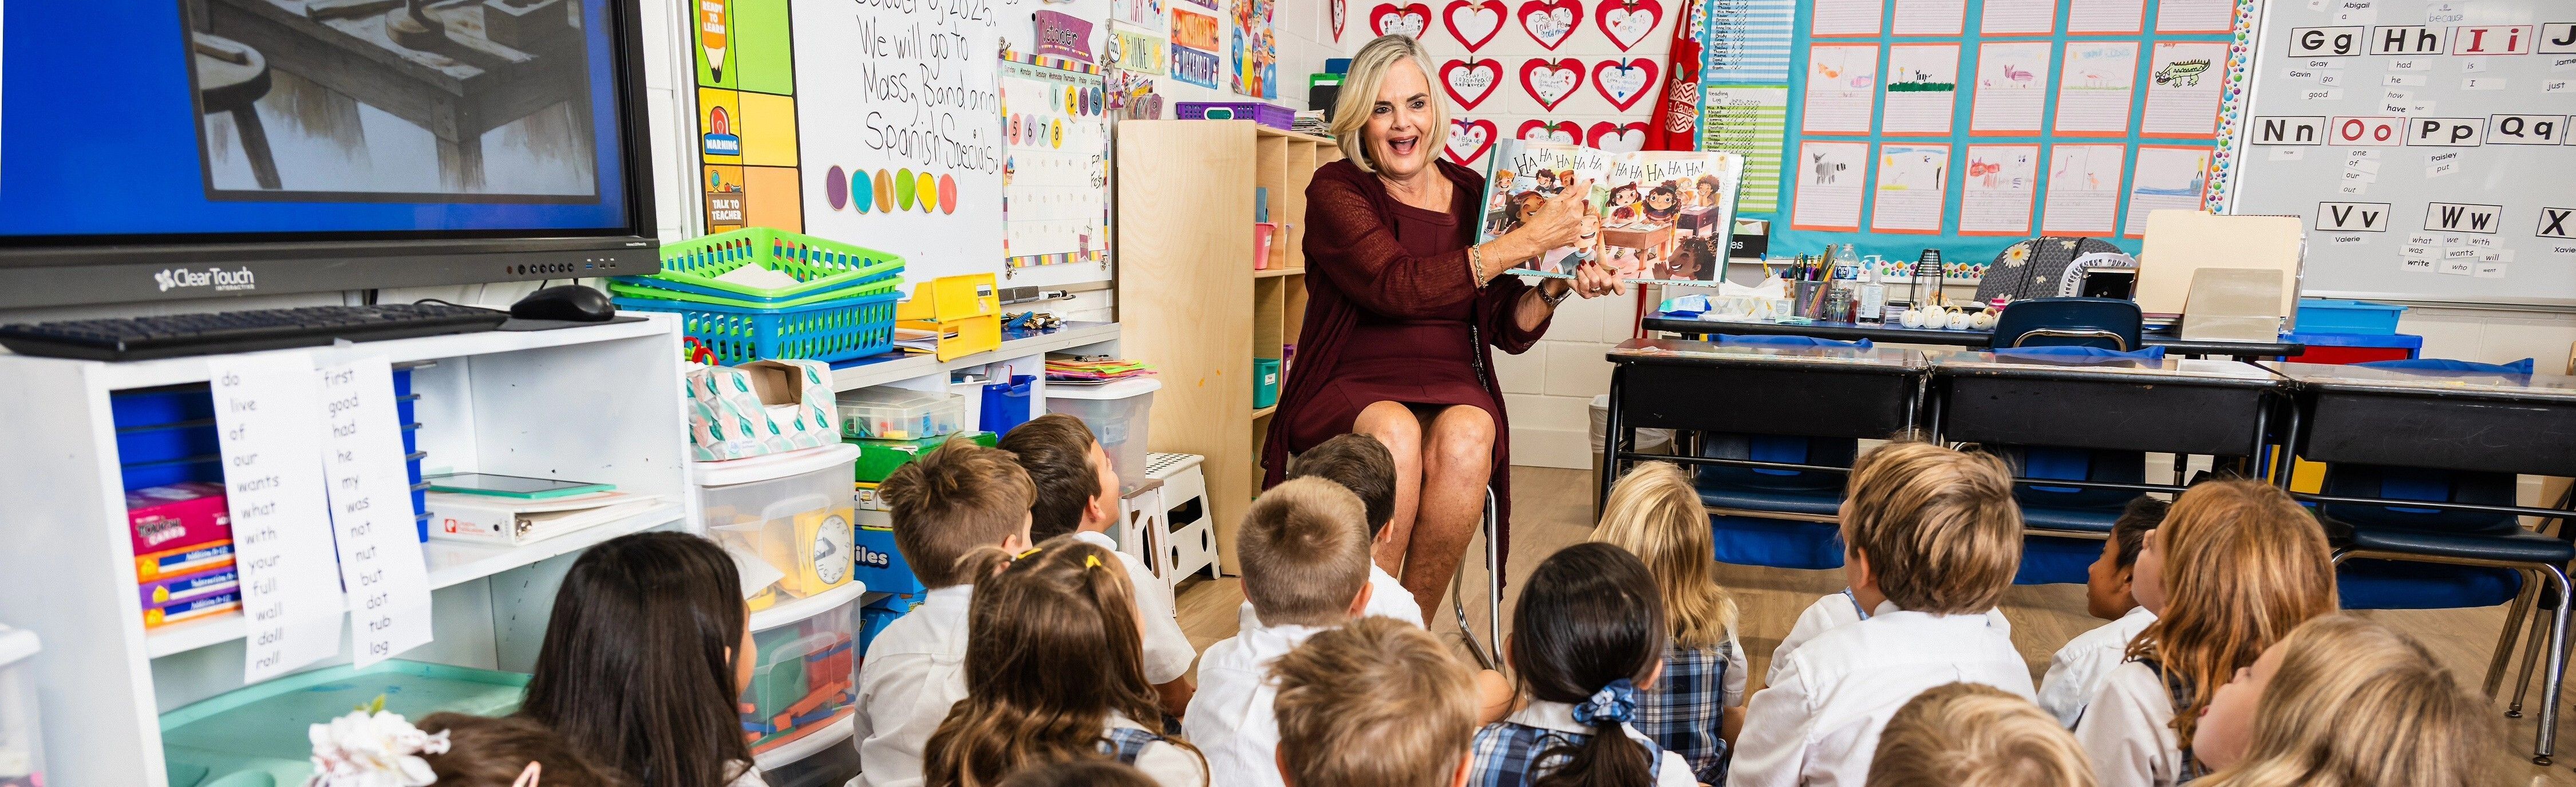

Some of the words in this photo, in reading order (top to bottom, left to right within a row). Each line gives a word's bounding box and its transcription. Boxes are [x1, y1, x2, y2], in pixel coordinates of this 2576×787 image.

[702, 1, 722, 14] READY
[1534, 13, 1560, 23] Jesus
[1564, 8, 1571, 18] is
[709, 13, 718, 23] TO
[2429, 13, 2463, 22] because
[704, 22, 725, 35] LEARN
[1042, 18, 1078, 48] October
[1182, 13, 1210, 47] NOVEMBER
[1535, 22, 1552, 33] love
[856, 15, 887, 58] We
[894, 22, 922, 60] will
[930, 33, 948, 80] go
[951, 21, 968, 61] to
[1111, 41, 1119, 54] COOL
[1131, 37, 1147, 69] JUNE
[1005, 65, 1016, 74] Sunday
[1020, 68, 1032, 77] Monday
[1036, 70, 1046, 80] Tuesday
[1049, 72, 1062, 81] Wednesday
[1063, 74, 1076, 84] Thursday
[1183, 50, 1210, 85] DECEMBER
[863, 61, 918, 127] Mass,
[919, 63, 965, 111] Band
[970, 72, 997, 121] and
[2547, 82, 2565, 91] just
[1069, 93, 1073, 108] 2
[1081, 95, 1086, 109] 3
[1092, 93, 1099, 109] 4
[2309, 91, 2328, 99] good
[2387, 104, 2405, 112] have
[1013, 121, 1017, 136] 5
[1028, 123, 1032, 137] 6
[1041, 123, 1046, 137] 7
[1055, 127, 1059, 140] 8
[1535, 132, 1562, 141] Jesus
[706, 138, 738, 151] WARNING
[865, 111, 941, 166] Spanish
[941, 113, 998, 184] Specials.
[1514, 154, 1537, 175] HA
[1540, 148, 1552, 162] HA
[1556, 155, 1570, 168] HA
[1574, 156, 1586, 170] HA
[1590, 156, 1602, 170] HA
[2431, 152, 2457, 162] Paisley
[1616, 163, 1627, 176] HA
[1630, 166, 1642, 179] HA
[1647, 165, 1665, 181] HA
[1668, 162, 1681, 175] HA
[2436, 164, 2449, 173] put
[713, 199, 729, 210] TALK
[729, 199, 739, 209] TO
[712, 210, 741, 221] TEACHER
[2412, 237, 2432, 245] what
[2472, 238, 2490, 246] with
[222, 371, 240, 386] do
[325, 370, 353, 388] first
[230, 398, 256, 412] live
[329, 391, 358, 418] good
[230, 423, 244, 440] of
[333, 419, 355, 438] had
[234, 453, 258, 467] our
[337, 449, 353, 463] he
[238, 475, 279, 493] wants
[342, 475, 358, 490] my
[242, 502, 275, 518] what
[347, 497, 369, 513] was
[245, 526, 277, 544] with
[351, 521, 371, 537] not
[355, 545, 376, 562] nut
[856, 546, 887, 565] iles
[248, 554, 279, 574] your
[360, 569, 382, 586] but
[252, 577, 276, 596] full
[366, 592, 388, 609] dot
[256, 601, 283, 621] wall
[369, 615, 392, 632] tub
[258, 626, 283, 646] doll
[370, 641, 389, 655] log
[256, 650, 280, 669] roll
